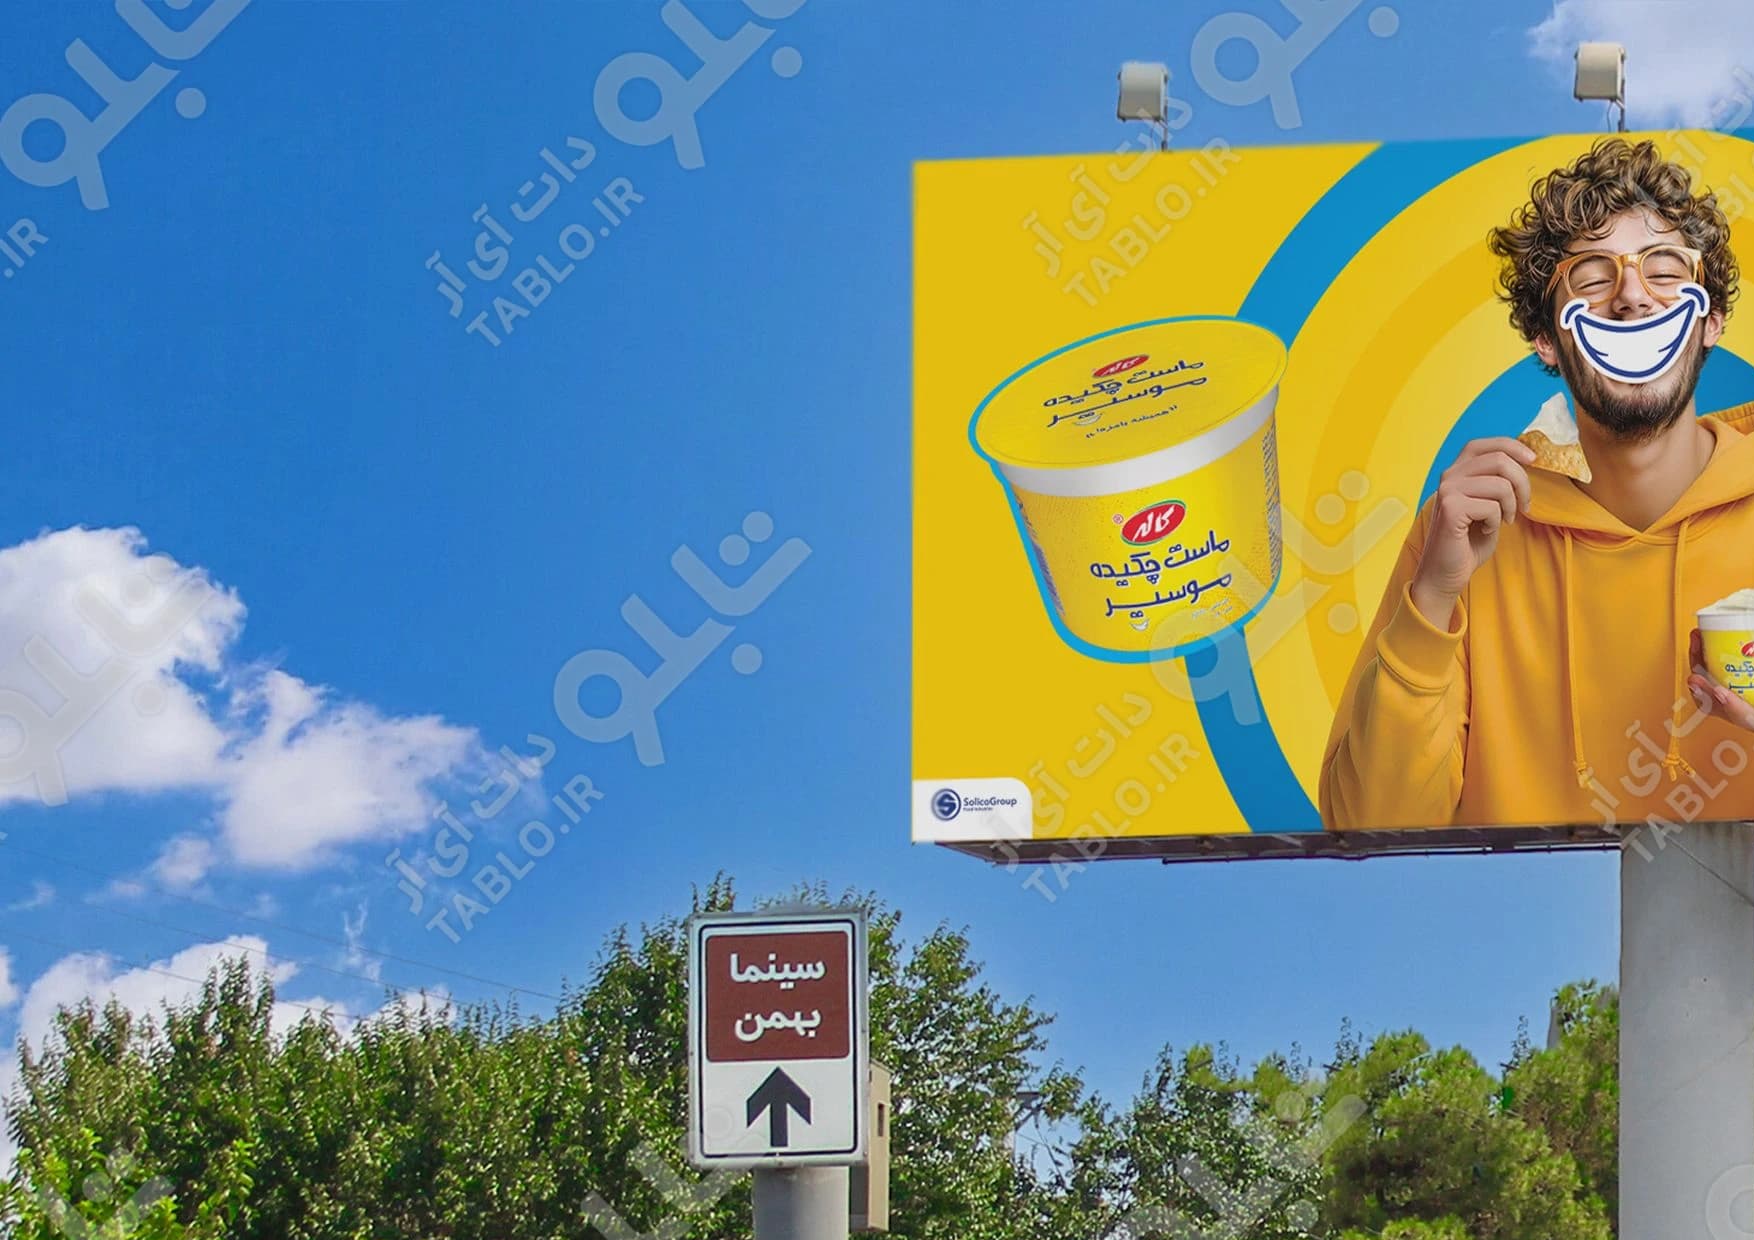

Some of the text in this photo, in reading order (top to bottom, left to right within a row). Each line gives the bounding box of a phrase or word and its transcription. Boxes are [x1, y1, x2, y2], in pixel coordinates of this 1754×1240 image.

[1043, 360, 1205, 407] ماست چکیده
[1047, 377, 1208, 428] موسیر
[1133, 504, 1176, 542] کاله
[1090, 530, 1230, 586] ماست چکیده
[1105, 573, 1232, 619] موسیر
[963, 796, 1018, 808] SolicoGroup
[730, 952, 826, 990] سینما
[735, 1008, 822, 1042] بهمن
